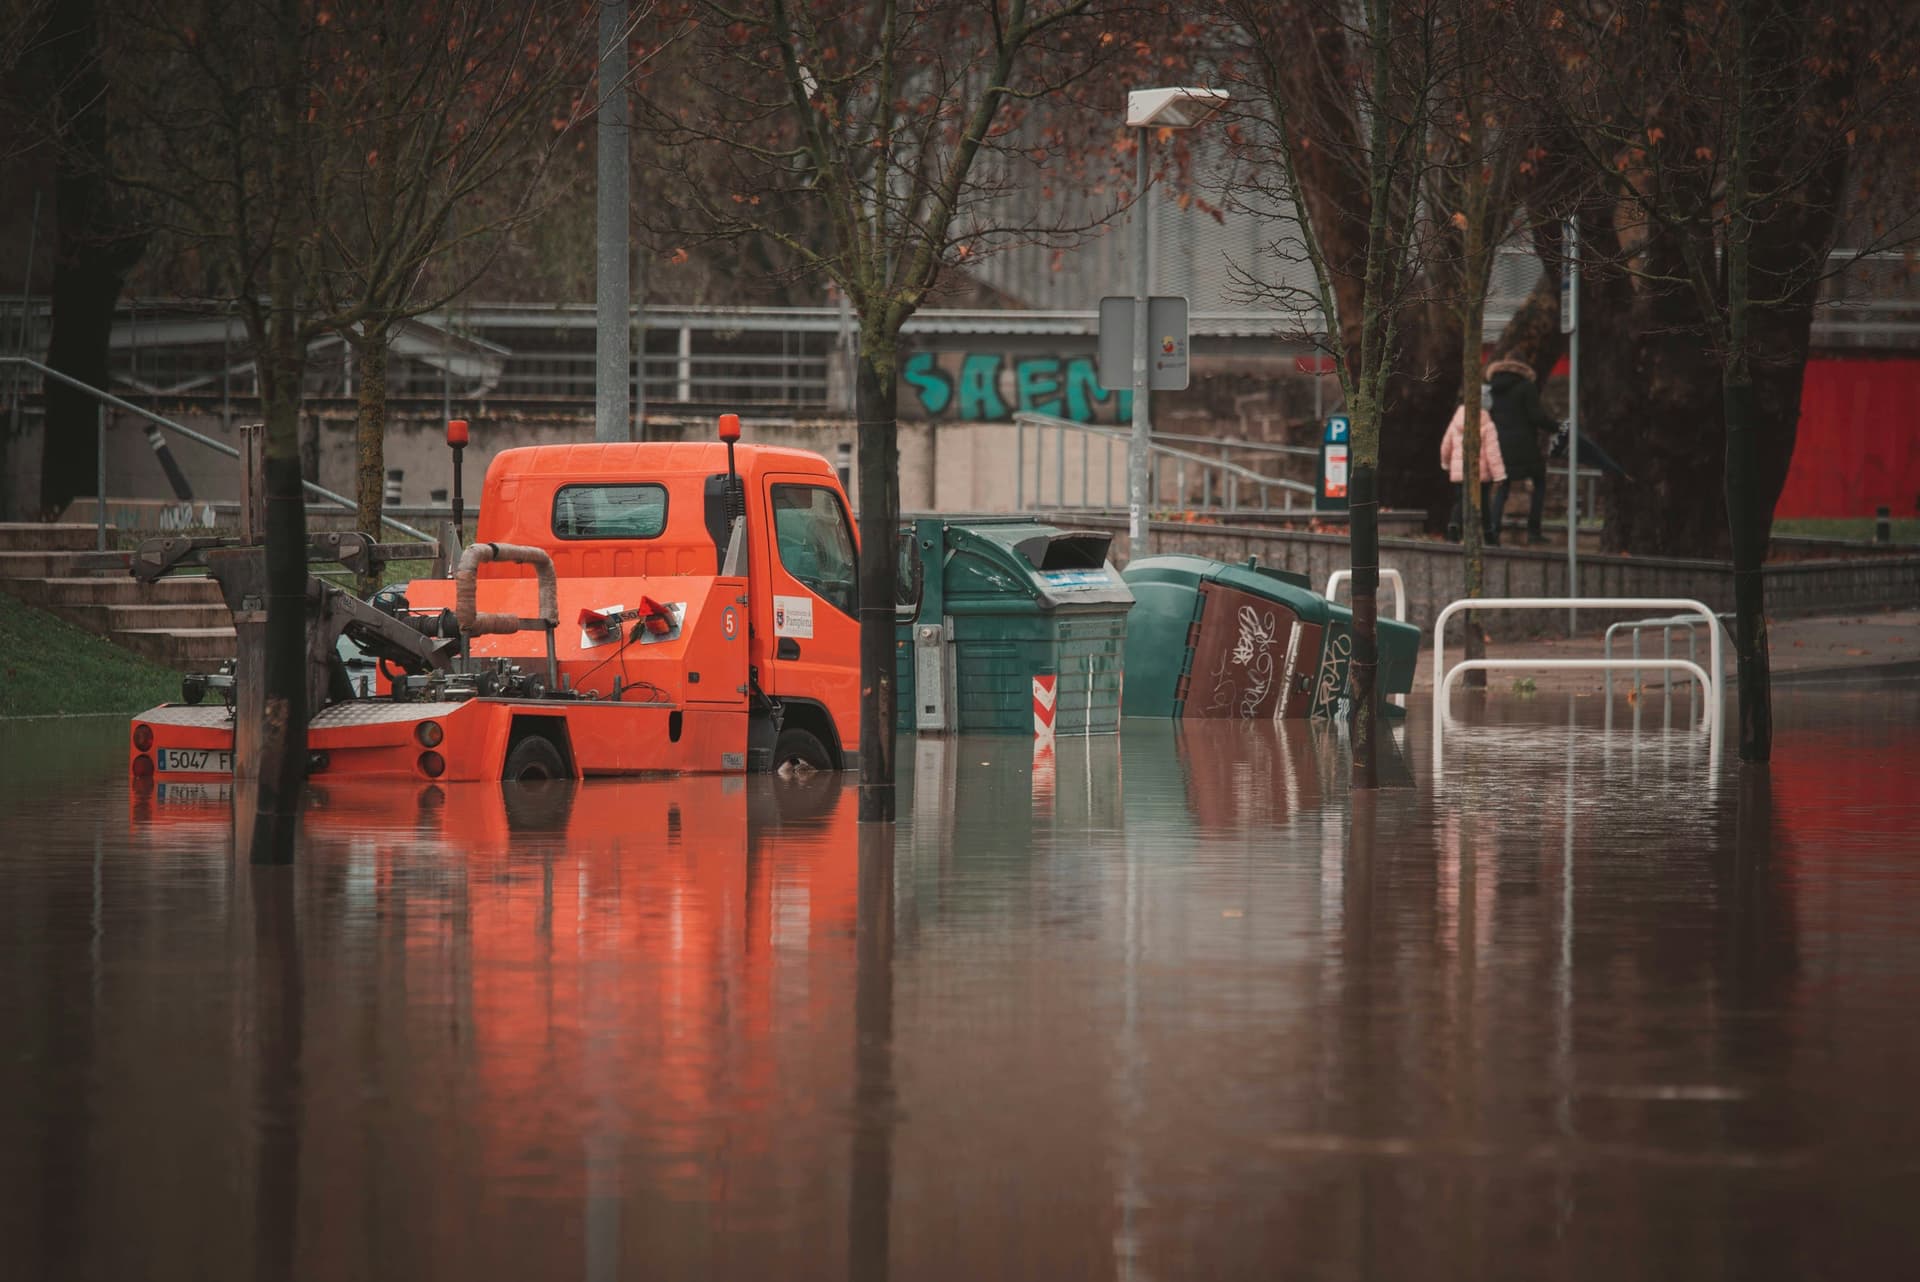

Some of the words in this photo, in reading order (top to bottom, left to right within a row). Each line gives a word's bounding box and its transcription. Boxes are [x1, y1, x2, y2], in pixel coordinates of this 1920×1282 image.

[1331, 419, 1346, 441] P
[726, 614, 734, 633] 5
[169, 752, 209, 769] 5047
